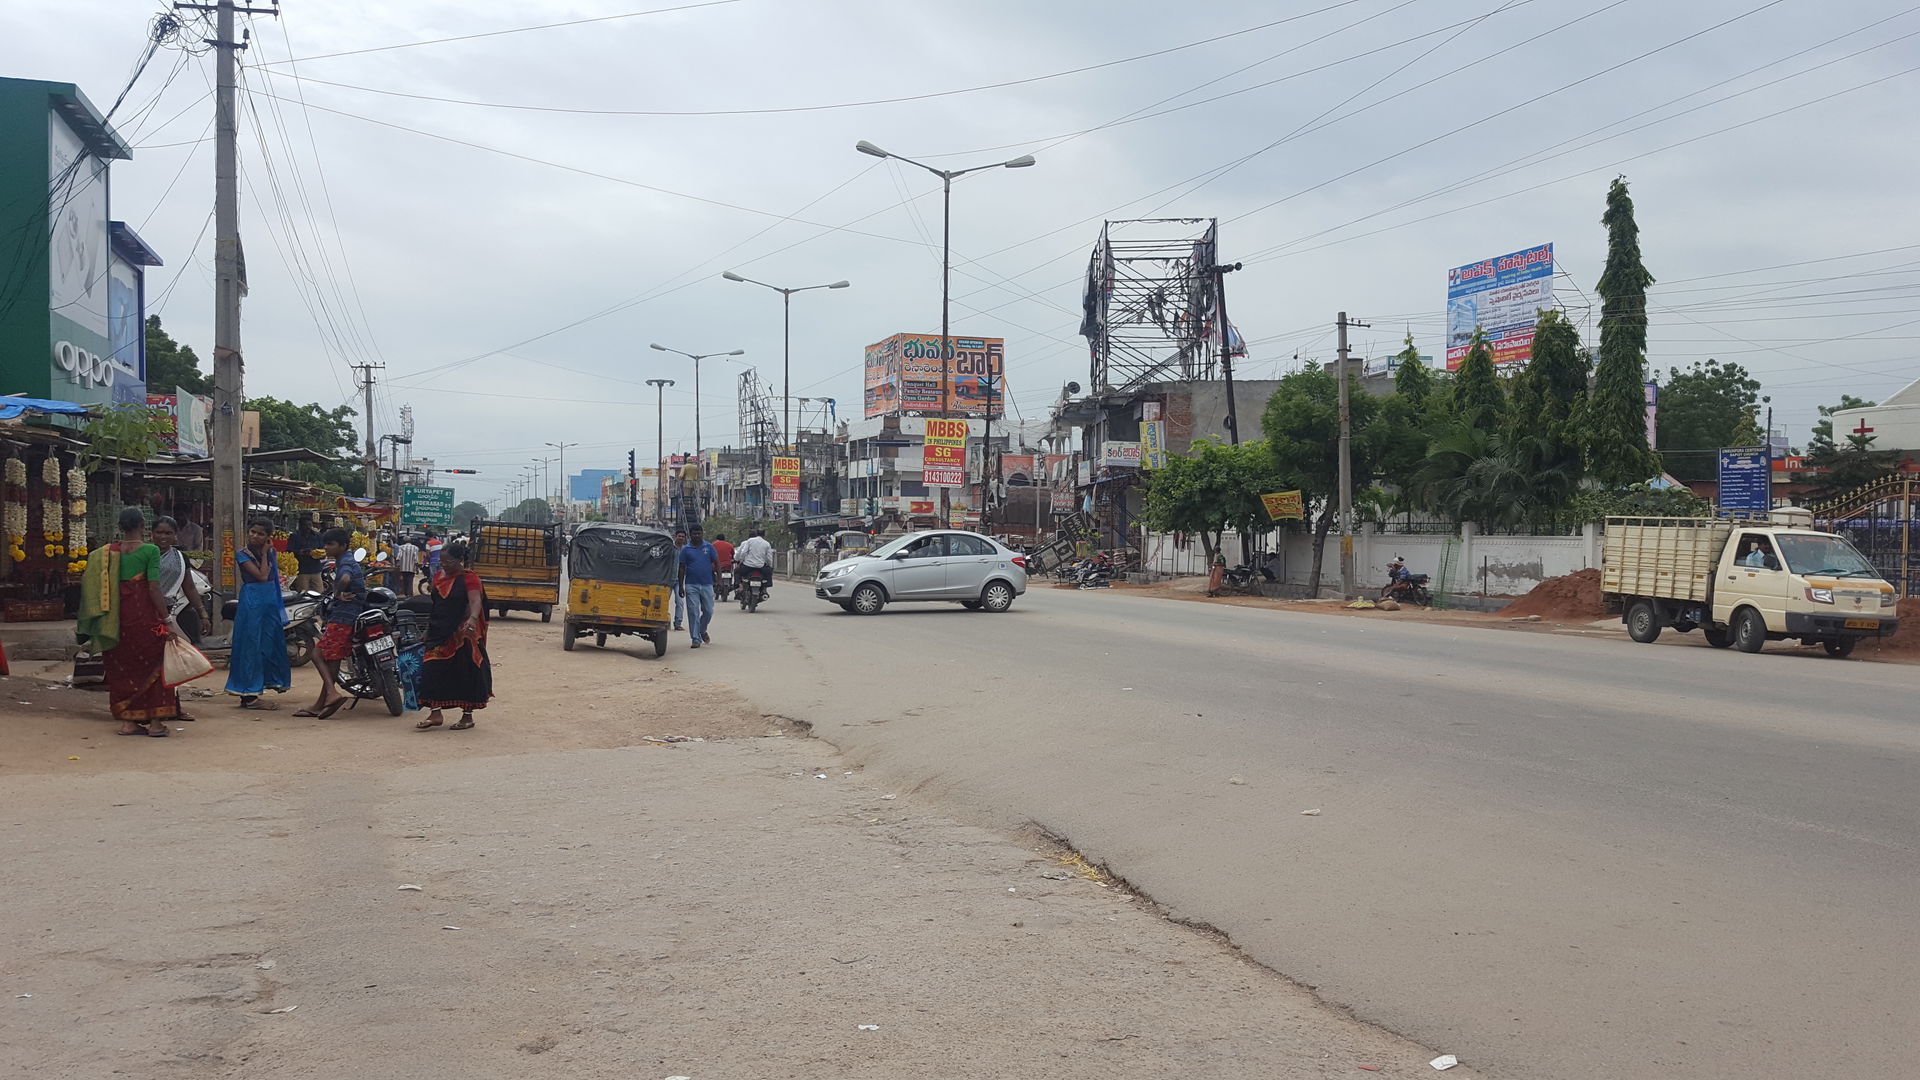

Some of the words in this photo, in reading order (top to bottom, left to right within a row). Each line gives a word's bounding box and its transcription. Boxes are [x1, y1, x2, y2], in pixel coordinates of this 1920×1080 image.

[927, 420, 965, 438] MBBS
[935, 447, 952, 457] SG
[774, 458, 799, 471] MBBS
[780, 476, 791, 484] SG
[924, 470, 962, 483] 8143100222
